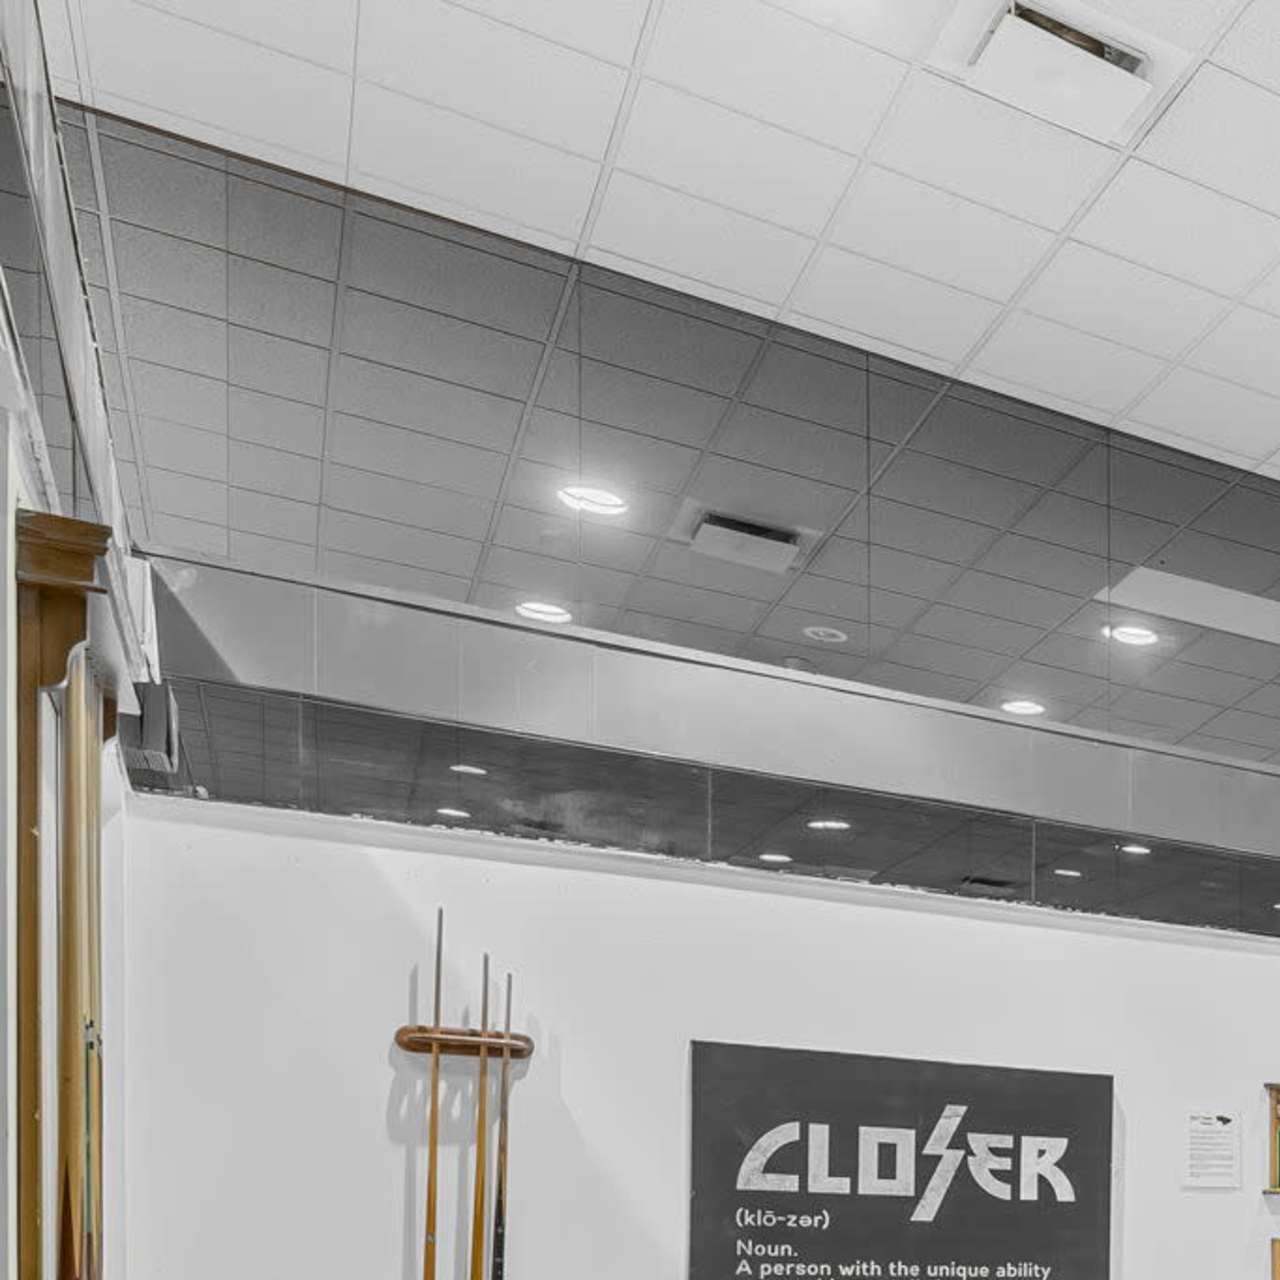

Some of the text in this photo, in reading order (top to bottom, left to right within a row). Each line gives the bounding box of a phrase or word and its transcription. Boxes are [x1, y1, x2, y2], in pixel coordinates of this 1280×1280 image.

[736, 1104, 1076, 1222] CLOSER
[736, 1239, 799, 1257] Noun.
[735, 1259, 753, 1275] A
[760, 1262, 832, 1280] person
[838, 1260, 882, 1277] with
[888, 1260, 920, 1277] the
